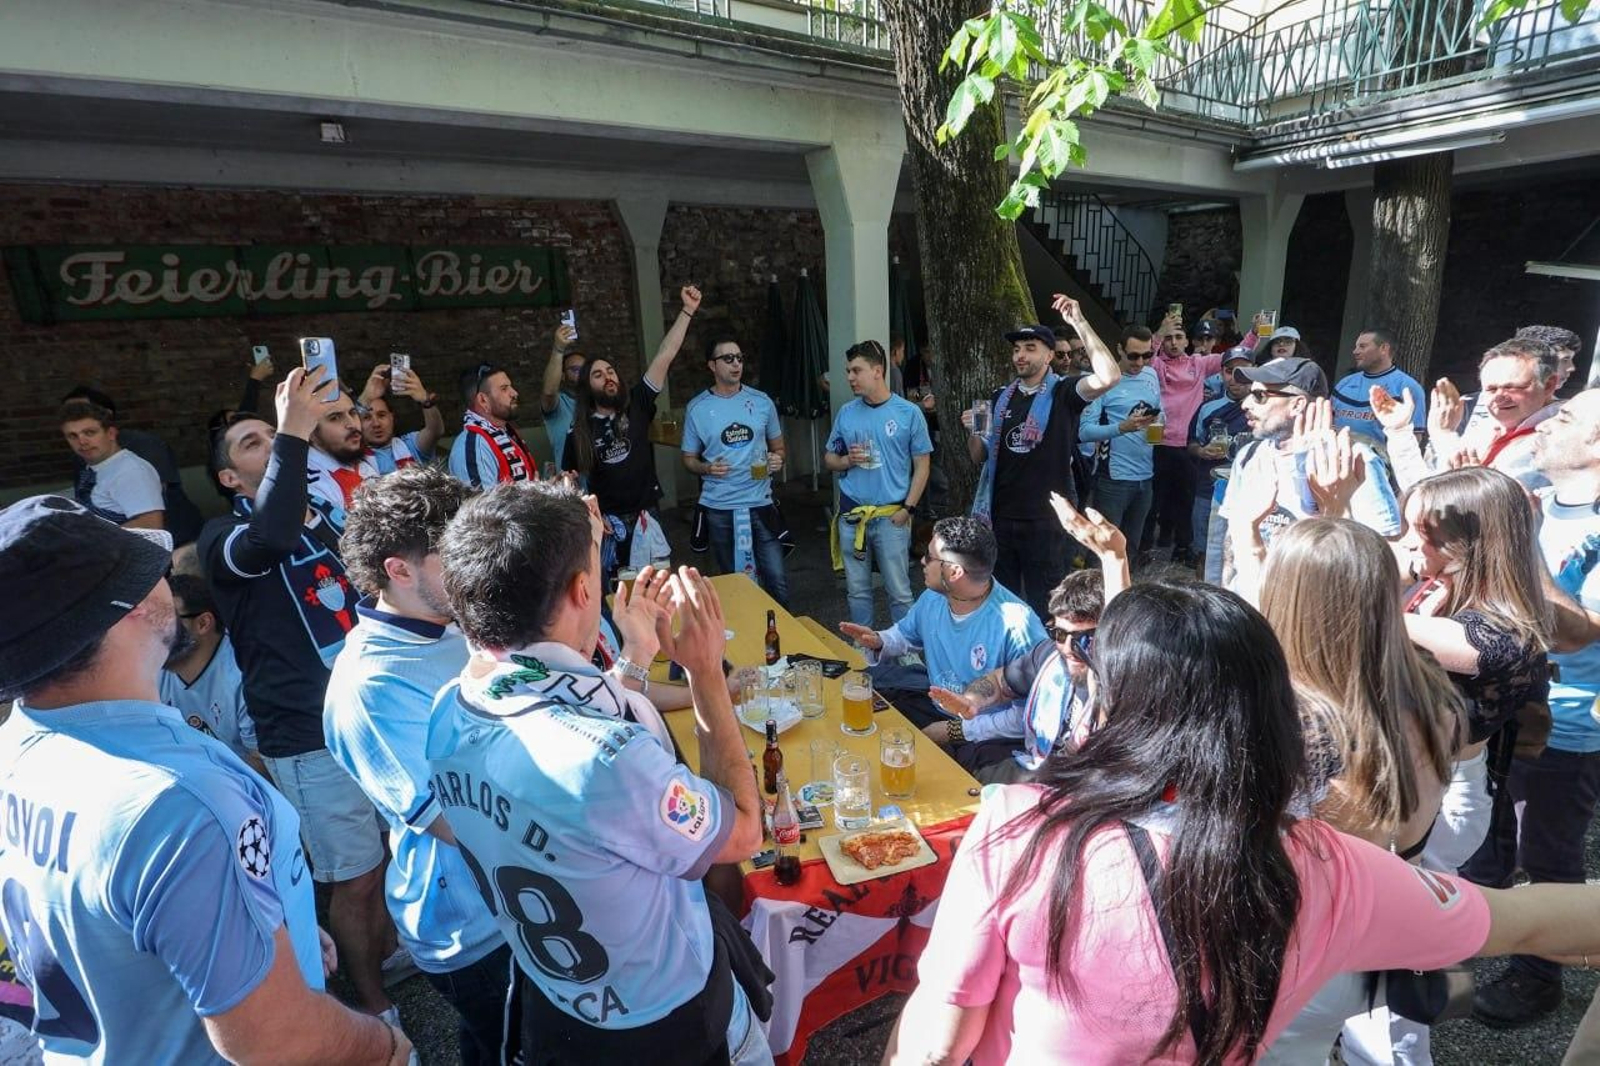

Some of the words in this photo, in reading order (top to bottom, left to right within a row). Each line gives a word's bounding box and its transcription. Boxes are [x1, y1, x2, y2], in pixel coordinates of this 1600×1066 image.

[59, 250, 543, 308] Feierling-Bier
[0, 790, 77, 874] OYOI
[522, 820, 556, 862] D.
[788, 884, 869, 945] REAL
[854, 953, 915, 993] VIG
[549, 985, 629, 1024] CA
